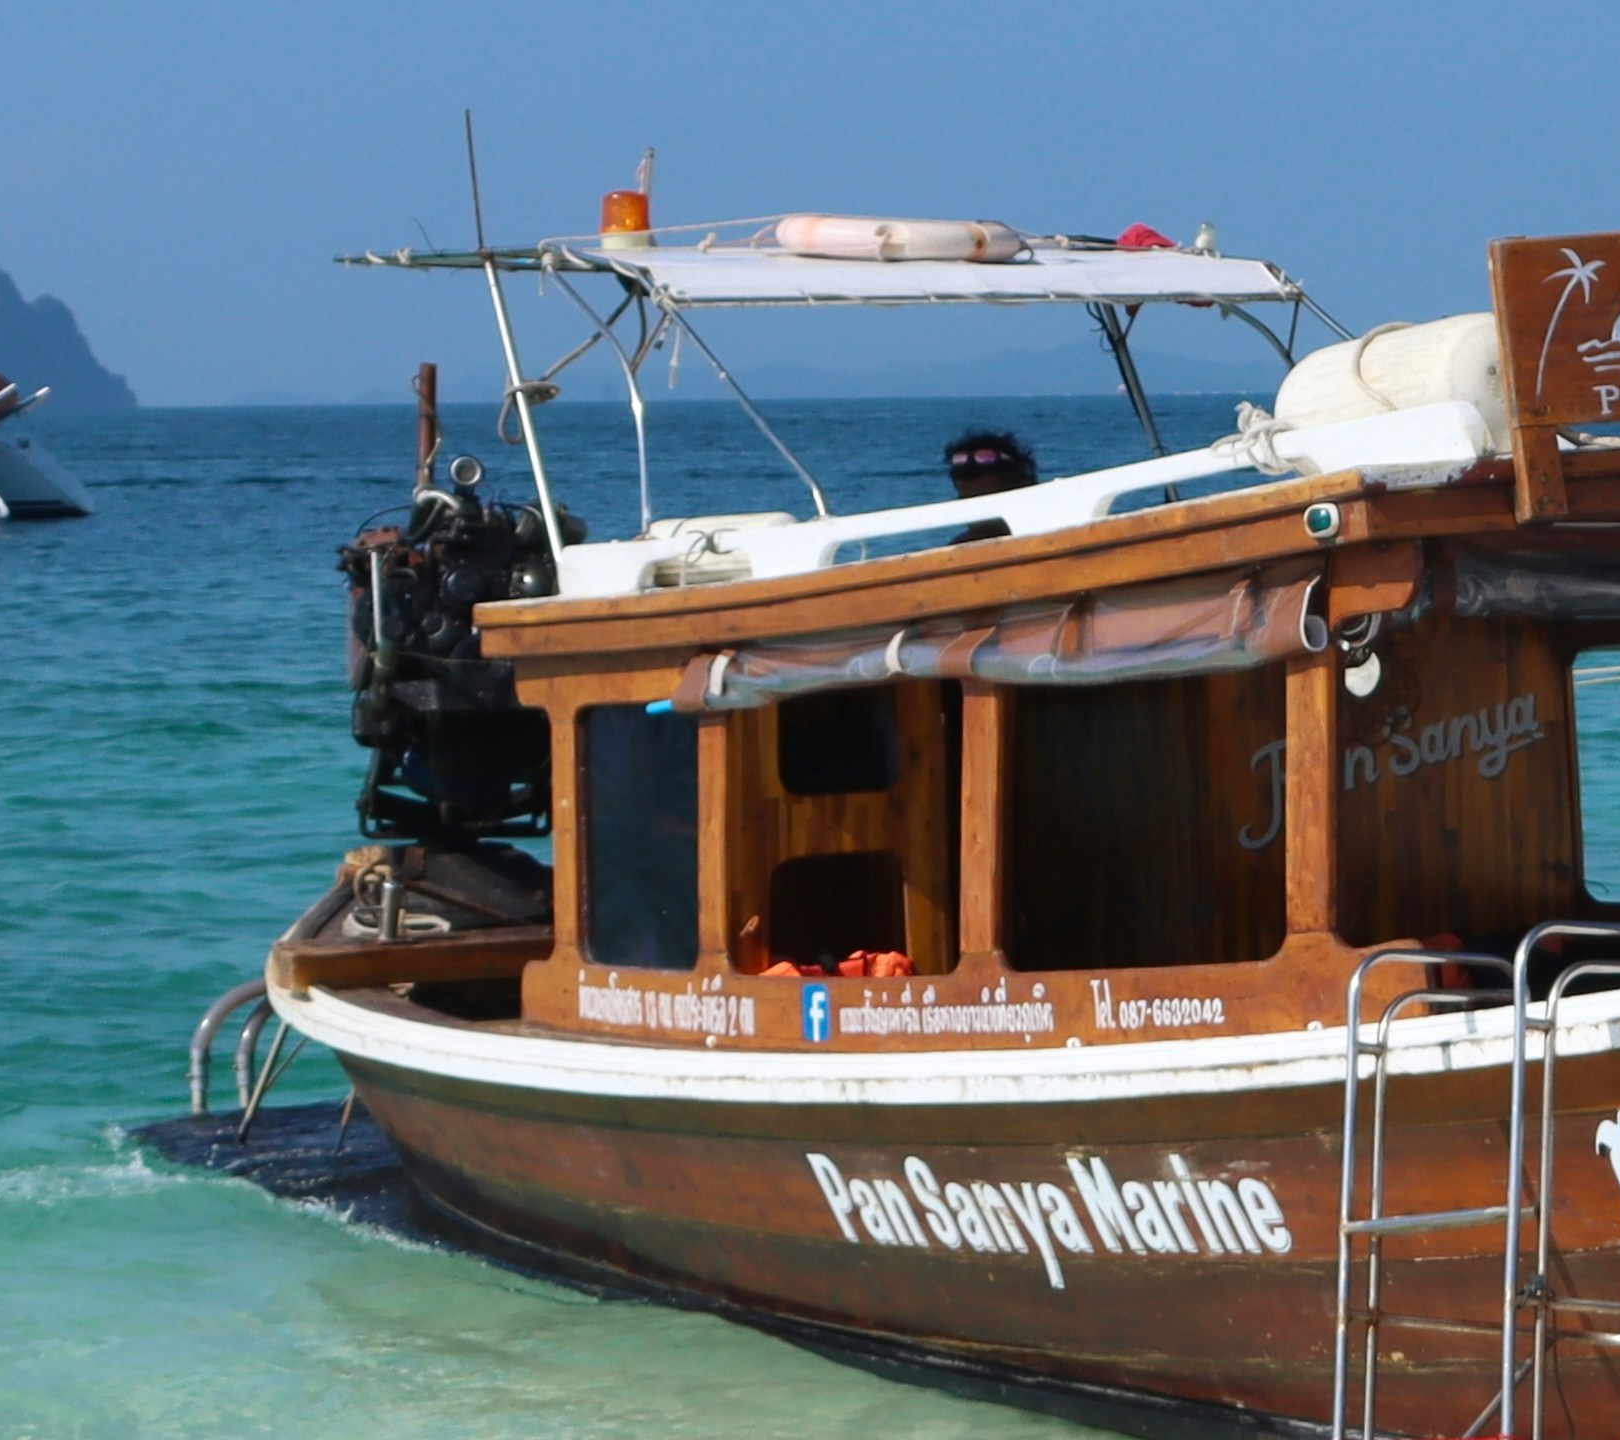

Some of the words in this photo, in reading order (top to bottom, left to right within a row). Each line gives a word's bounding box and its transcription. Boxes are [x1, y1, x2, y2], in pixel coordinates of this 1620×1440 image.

[1089, 977, 1116, 1029] Tel.
[1119, 997, 1225, 1030] 087-6632042
[806, 1153, 929, 1247] Pan
[904, 1155, 1094, 1290] Sanya
[1067, 1153, 1292, 1254] Marine
